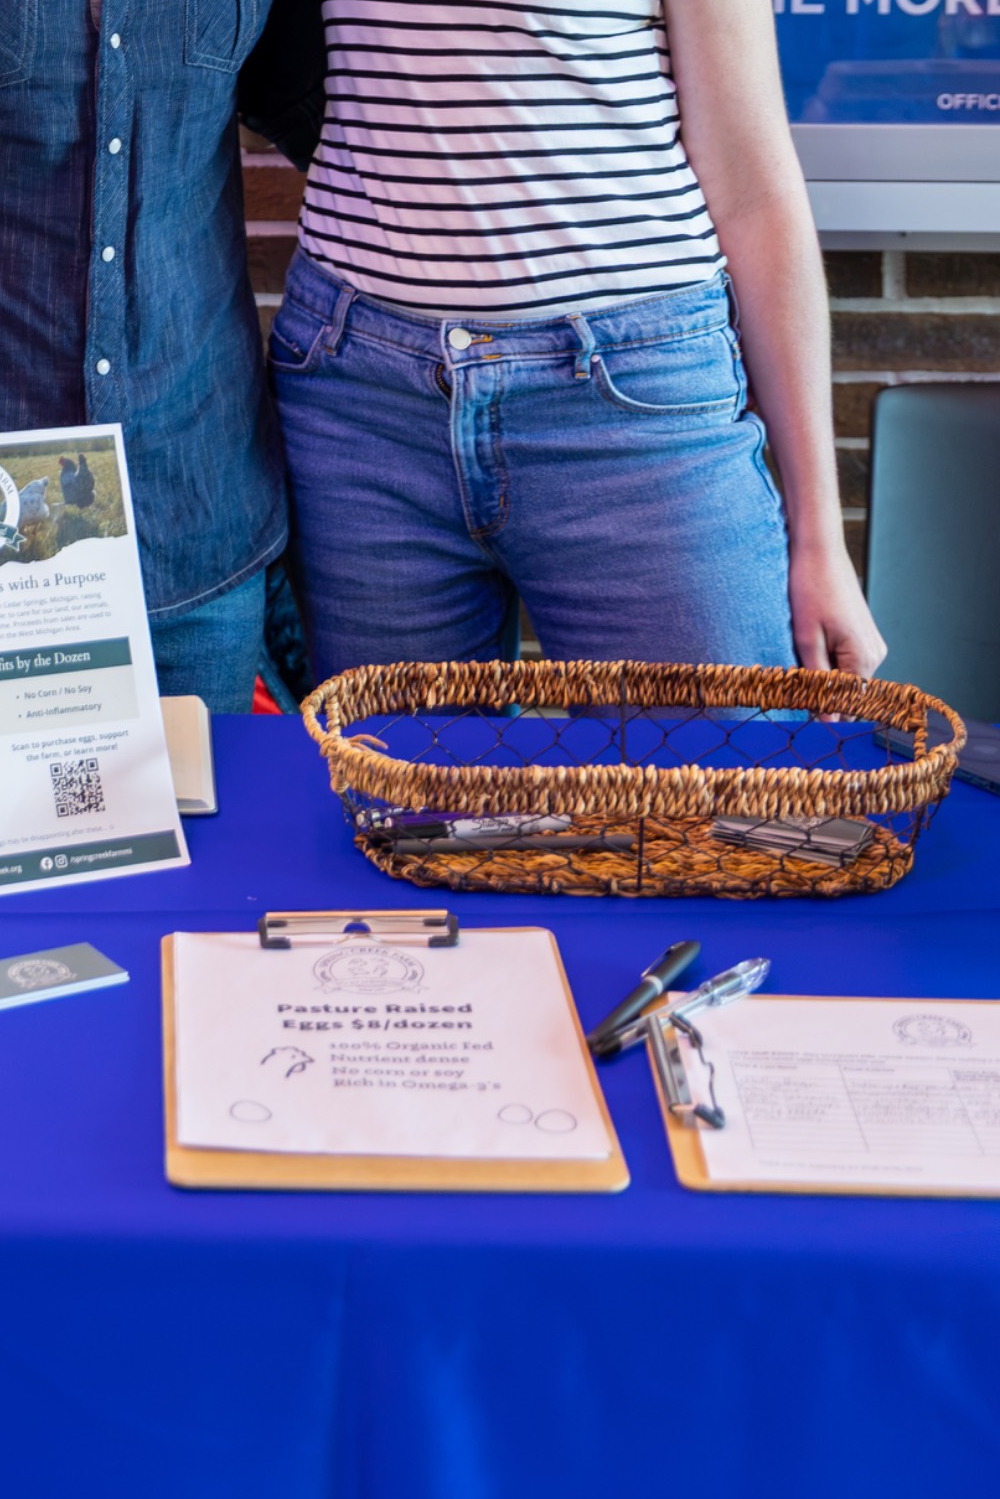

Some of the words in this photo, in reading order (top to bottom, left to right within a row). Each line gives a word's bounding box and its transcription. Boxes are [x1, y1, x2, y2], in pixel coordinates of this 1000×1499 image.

[936, 93, 1000, 111] OFFIC
[8, 573, 39, 591] with
[43, 578, 50, 587] a
[54, 571, 106, 589] Purpose
[17, 656, 31, 672] by
[34, 654, 52, 667] the
[55, 651, 91, 665] Dozen
[24, 692, 36, 700] No
[38, 688, 57, 698] Corn
[64, 686, 76, 695] No
[78, 684, 92, 695] Soy
[26, 702, 102, 719] Anti-inflammatory
[12, 742, 30, 752] Scan
[32, 740, 40, 749] to
[42, 735, 82, 749] purchase
[99, 729, 129, 743] support
[26, 753, 39, 762] the
[73, 746, 94, 756] learn
[96, 743, 118, 753] more!
[277, 1003, 378, 1014] Pasture
[385, 1003, 473, 1014] Raised
[282, 1018, 344, 1032] Eggs
[386, 1041, 457, 1052] Organic
[330, 1053, 411, 1063] Nutrient
[415, 1055, 470, 1064] dense
[332, 1067, 360, 1076] No
[364, 1068, 405, 1077] corn
[409, 1069, 429, 1077] or
[434, 1068, 465, 1079] soy
[333, 1078, 374, 1088] Rich
[379, 1079, 397, 1088] in
